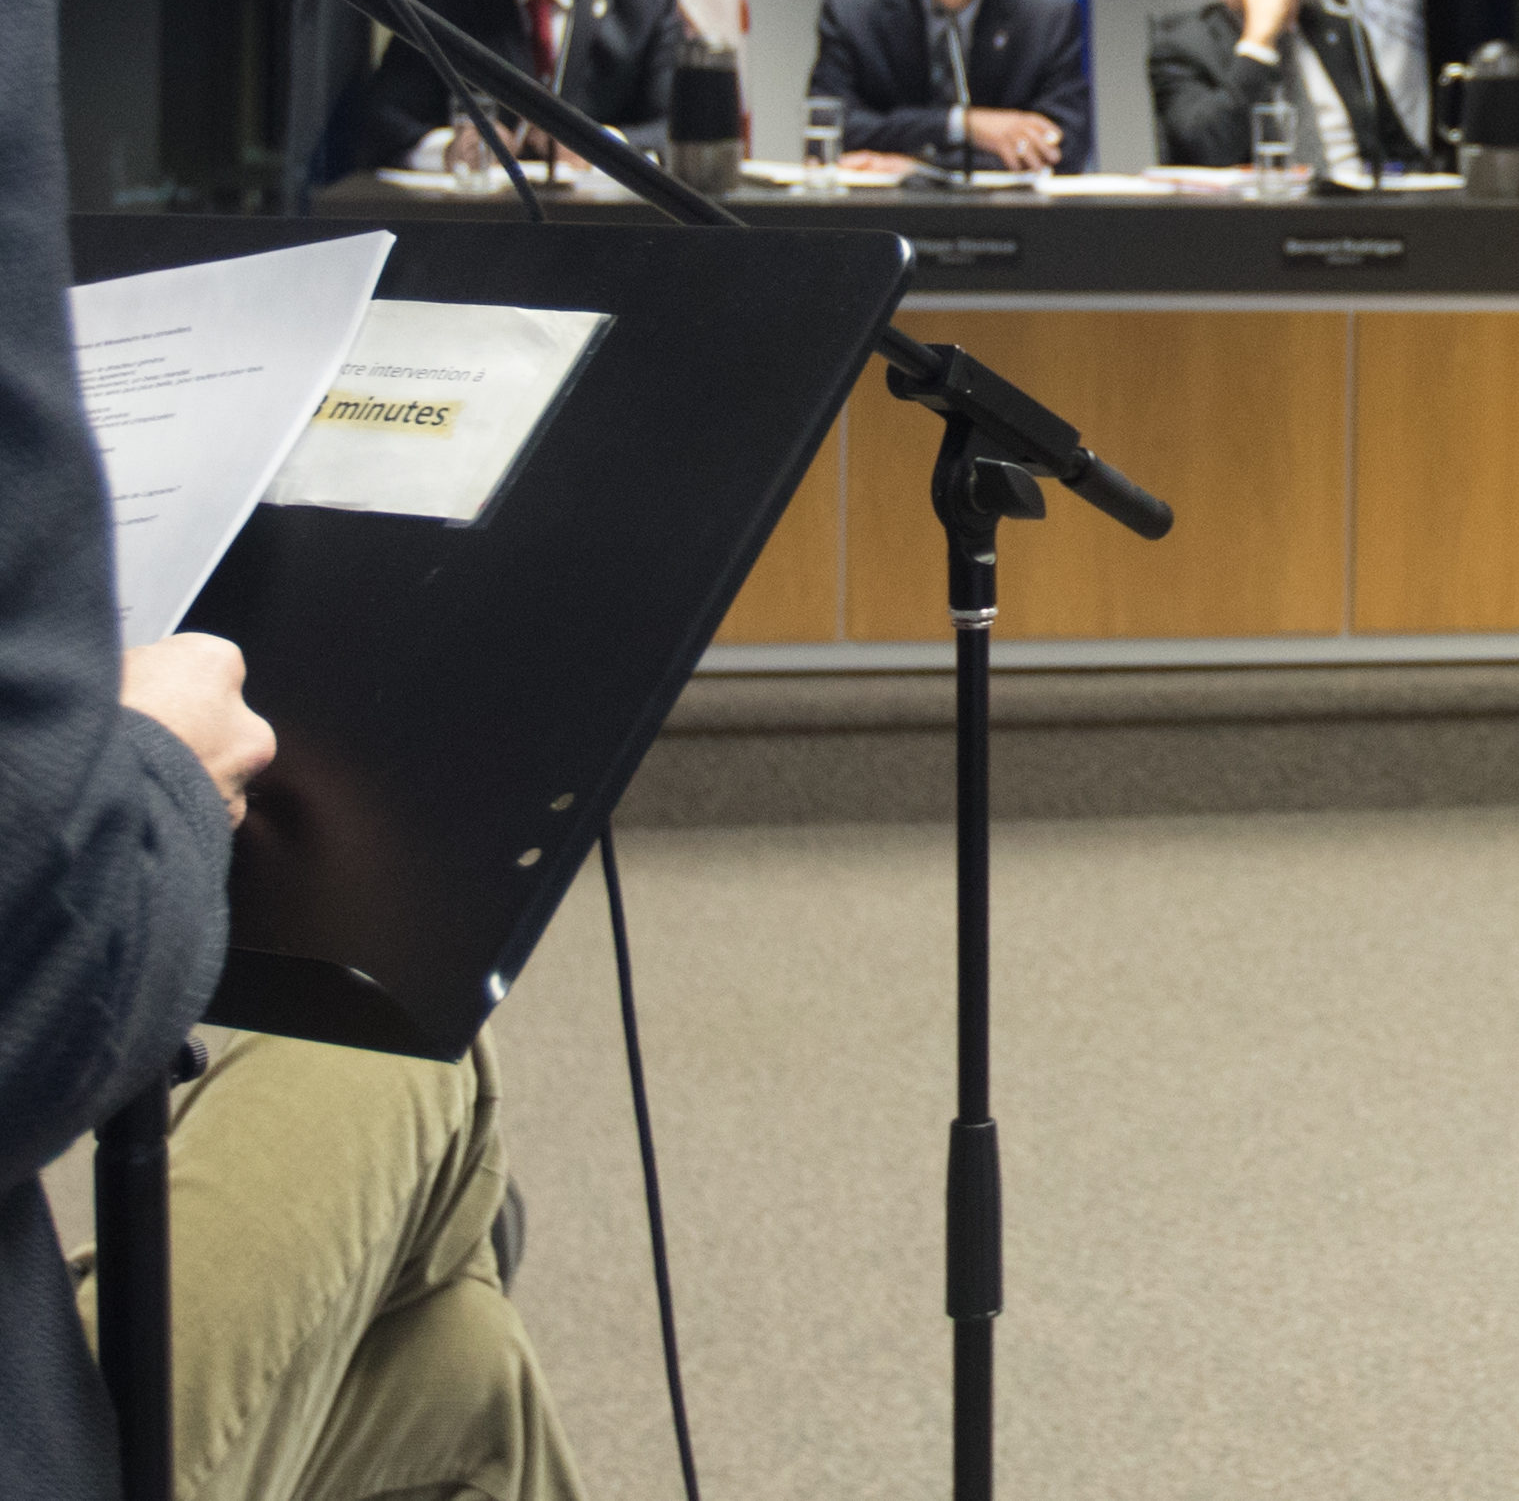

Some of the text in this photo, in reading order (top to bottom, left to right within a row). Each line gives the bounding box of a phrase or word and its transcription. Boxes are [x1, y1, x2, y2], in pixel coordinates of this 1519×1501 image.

[340, 362, 486, 382] tre intervention à
